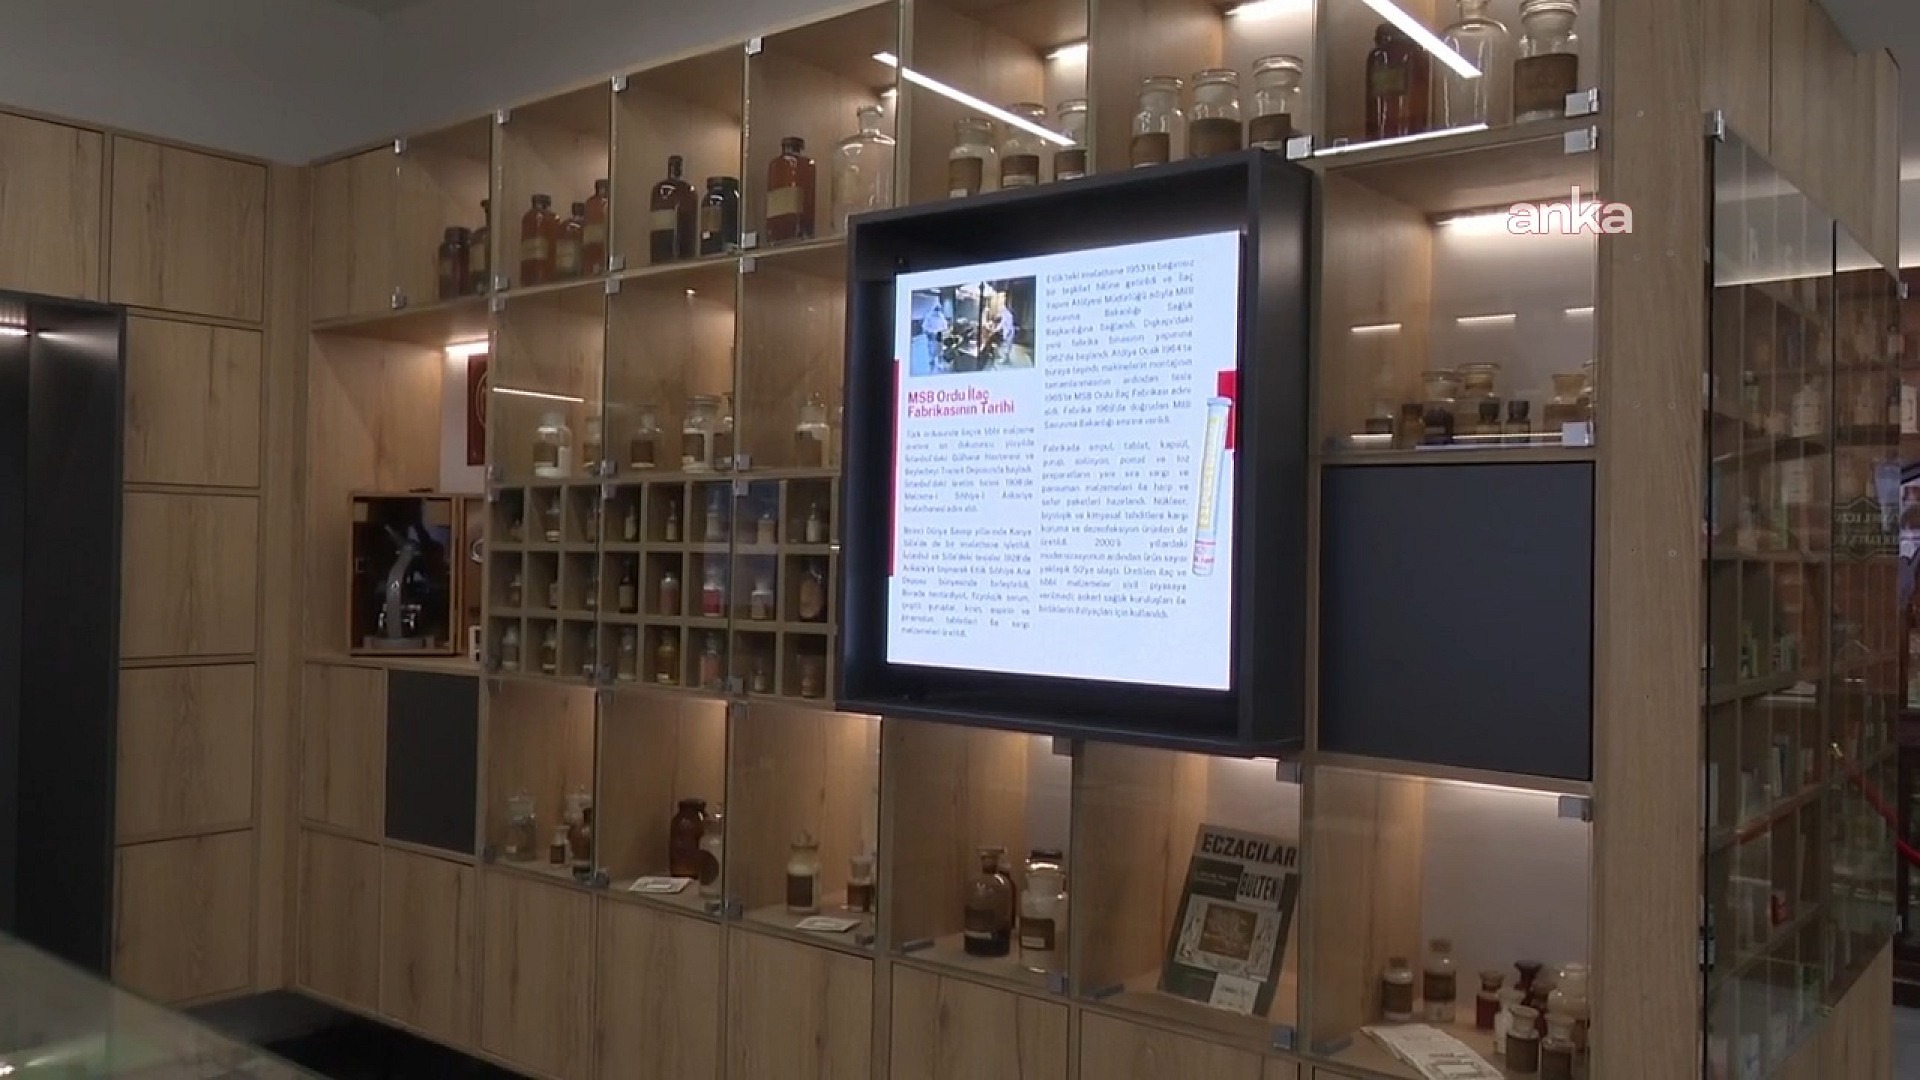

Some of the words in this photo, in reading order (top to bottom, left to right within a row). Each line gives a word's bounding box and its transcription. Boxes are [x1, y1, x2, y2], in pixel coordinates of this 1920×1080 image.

[908, 391, 934, 404] MSB
[936, 390, 966, 403] Ordu
[967, 385, 989, 401] İlaç
[908, 403, 977, 418] Fabrikasının
[981, 401, 1014, 415] Tarihi
[1201, 833, 1297, 868] ECZACILAR
